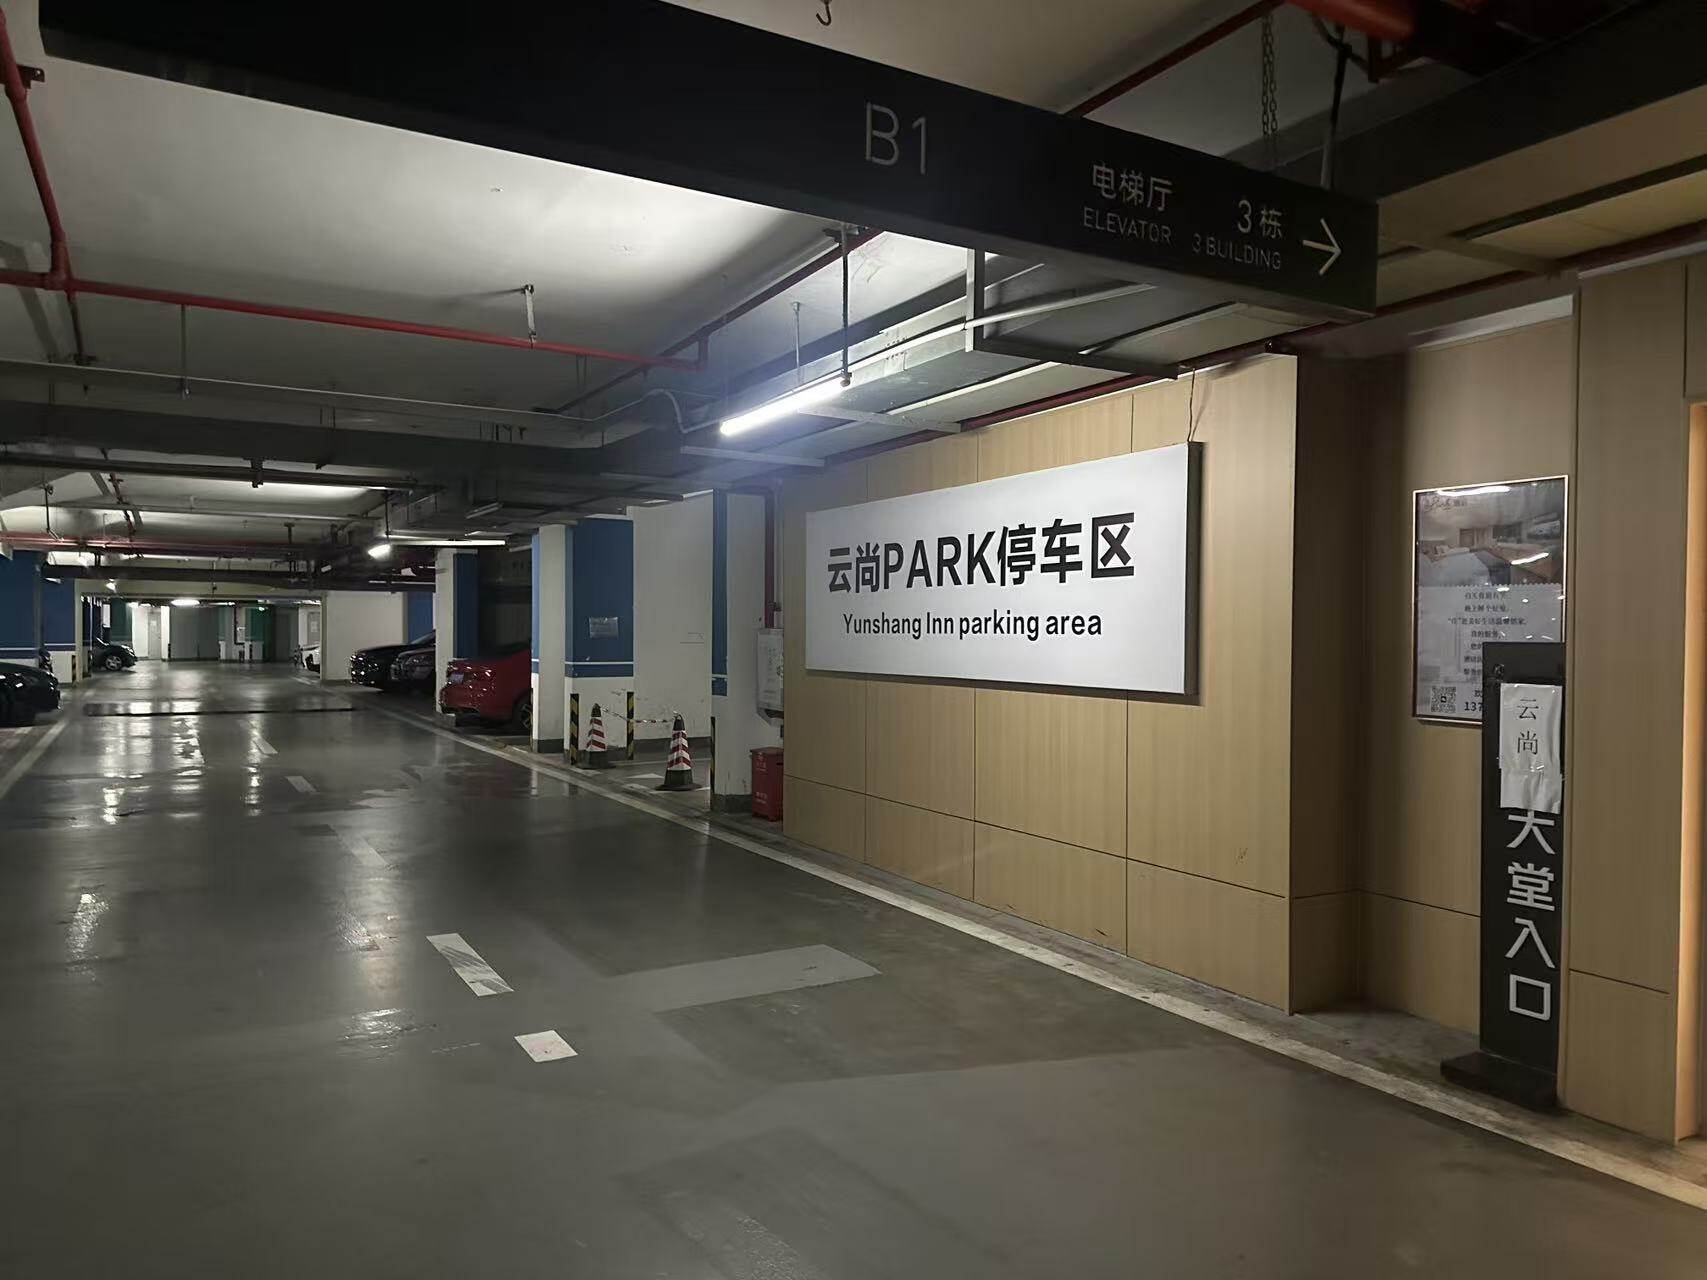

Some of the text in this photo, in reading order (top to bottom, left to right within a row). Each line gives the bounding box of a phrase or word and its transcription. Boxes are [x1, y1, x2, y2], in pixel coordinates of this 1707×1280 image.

[865, 102, 929, 175] B1
[1091, 162, 1174, 213] 电梯厅
[1083, 207, 1173, 245] ELEVATOR
[1206, 236, 1281, 271] BUILDING
[827, 512, 1135, 594] 云尚PARK停车区
[959, 609, 1040, 642] parking
[1046, 613, 1102, 636] area
[1516, 698, 1540, 755] 云尚
[1504, 809, 1556, 1022] 大堂入口
